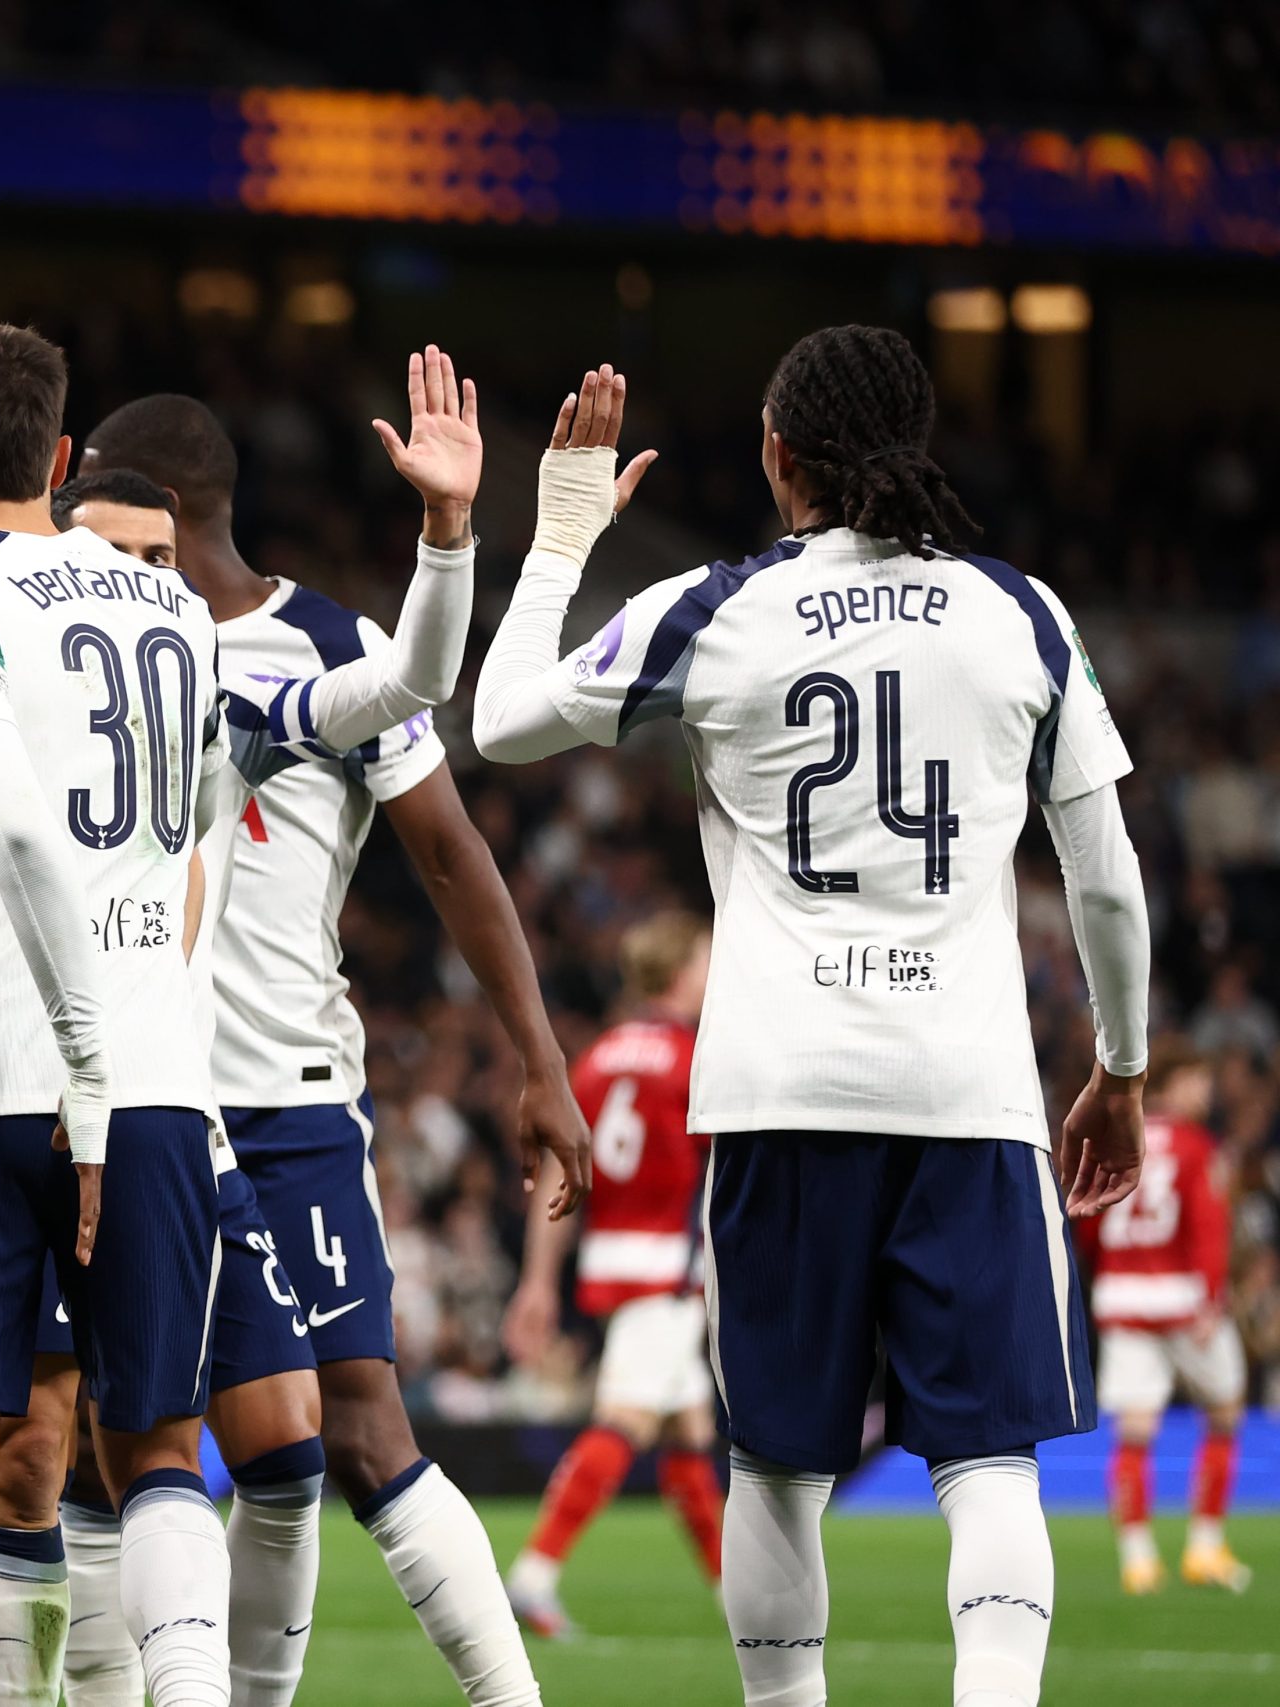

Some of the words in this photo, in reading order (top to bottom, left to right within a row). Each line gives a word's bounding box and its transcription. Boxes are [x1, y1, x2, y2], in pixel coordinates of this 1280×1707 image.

[7, 560, 189, 618] bentancur
[795, 584, 949, 640] spence
[61, 623, 196, 855] 30
[785, 670, 959, 895] 24
[592, 1075, 648, 1184] 6
[310, 1205, 348, 1287] 4
[956, 1594, 1051, 1620] SPURS
[736, 1637, 825, 1649] SPURS
